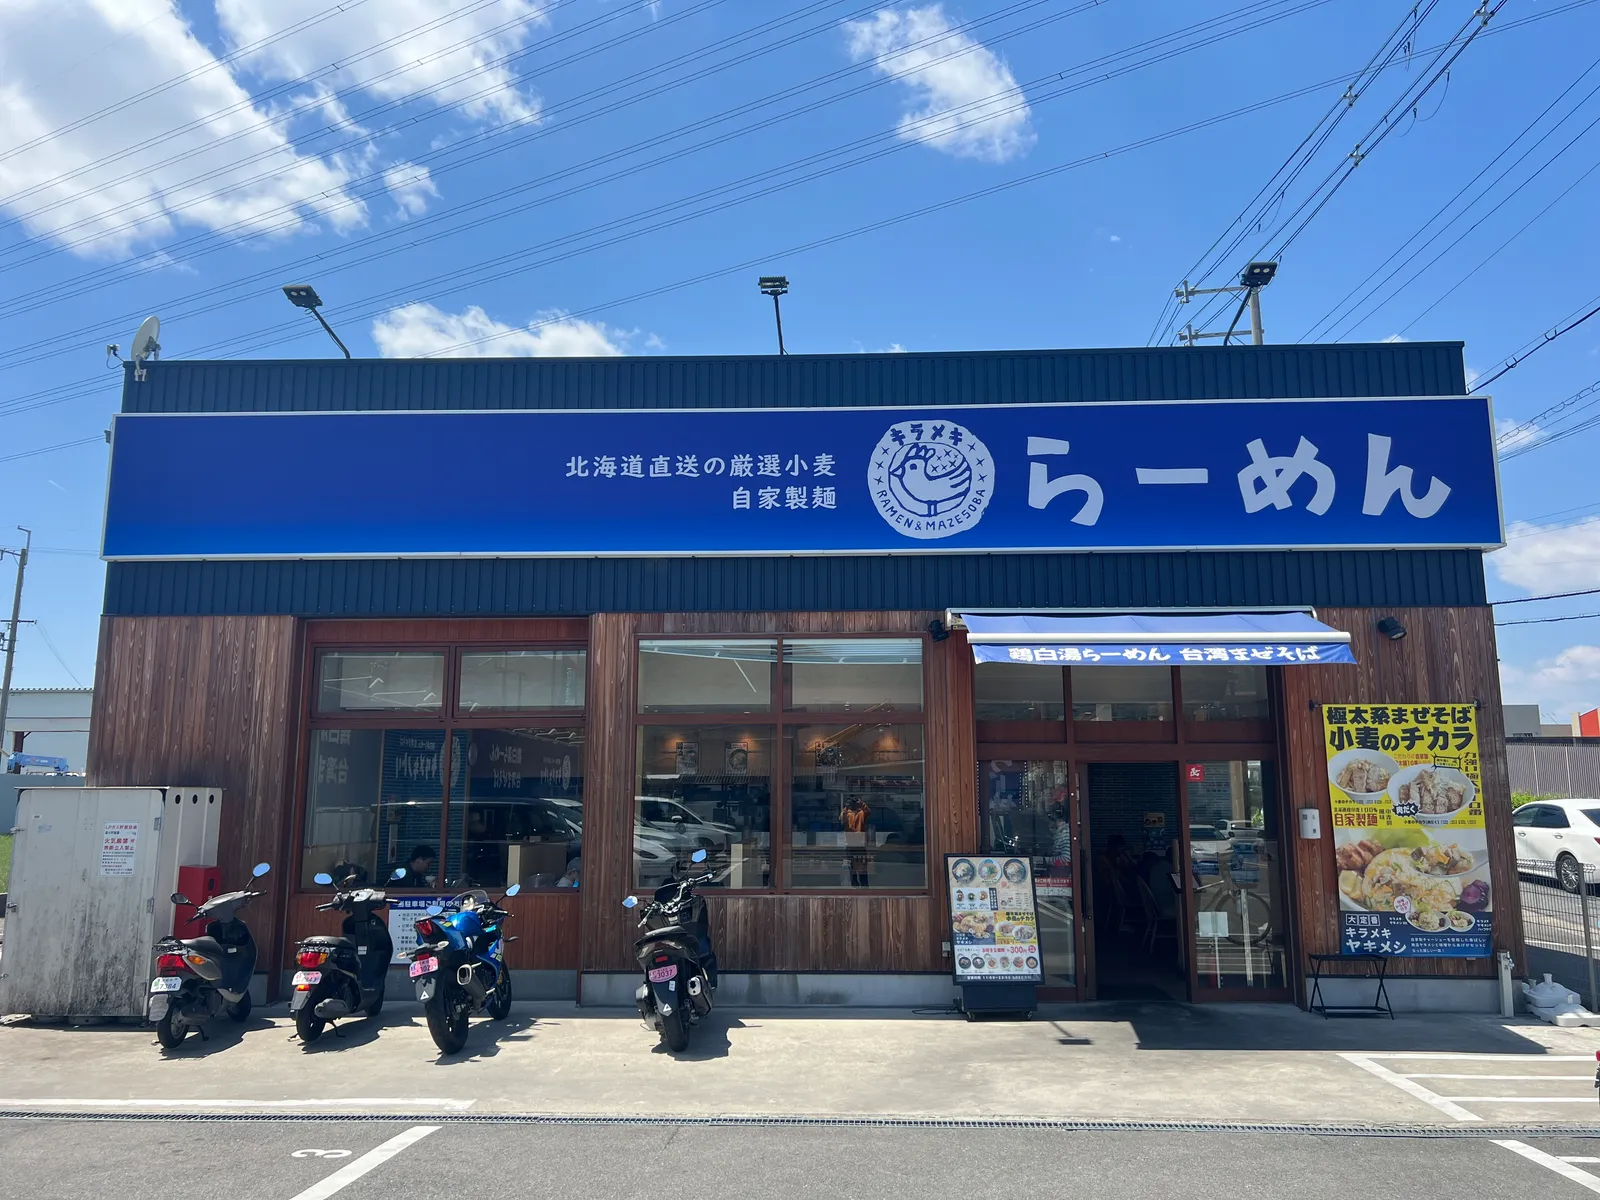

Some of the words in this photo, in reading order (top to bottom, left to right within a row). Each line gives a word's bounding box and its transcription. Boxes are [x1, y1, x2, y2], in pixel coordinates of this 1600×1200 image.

[890, 423, 963, 446] キラメキ
[565, 453, 837, 479] 北海道直送の厳選小麦
[1027, 433, 1452, 526] らーめん
[731, 485, 838, 510] 自家製麺
[1008, 647, 1171, 662] 鶏白湯らーめん
[1179, 645, 1320, 662] 台湾まぜそば
[1326, 706, 1472, 725] 極太系まぜそば
[1329, 726, 1475, 751] 小麦のチカラ
[1334, 813, 1378, 827] 自家製麺
[1346, 927, 1391, 939] キラメキ
[1346, 939, 1406, 954] ヤキメシ
